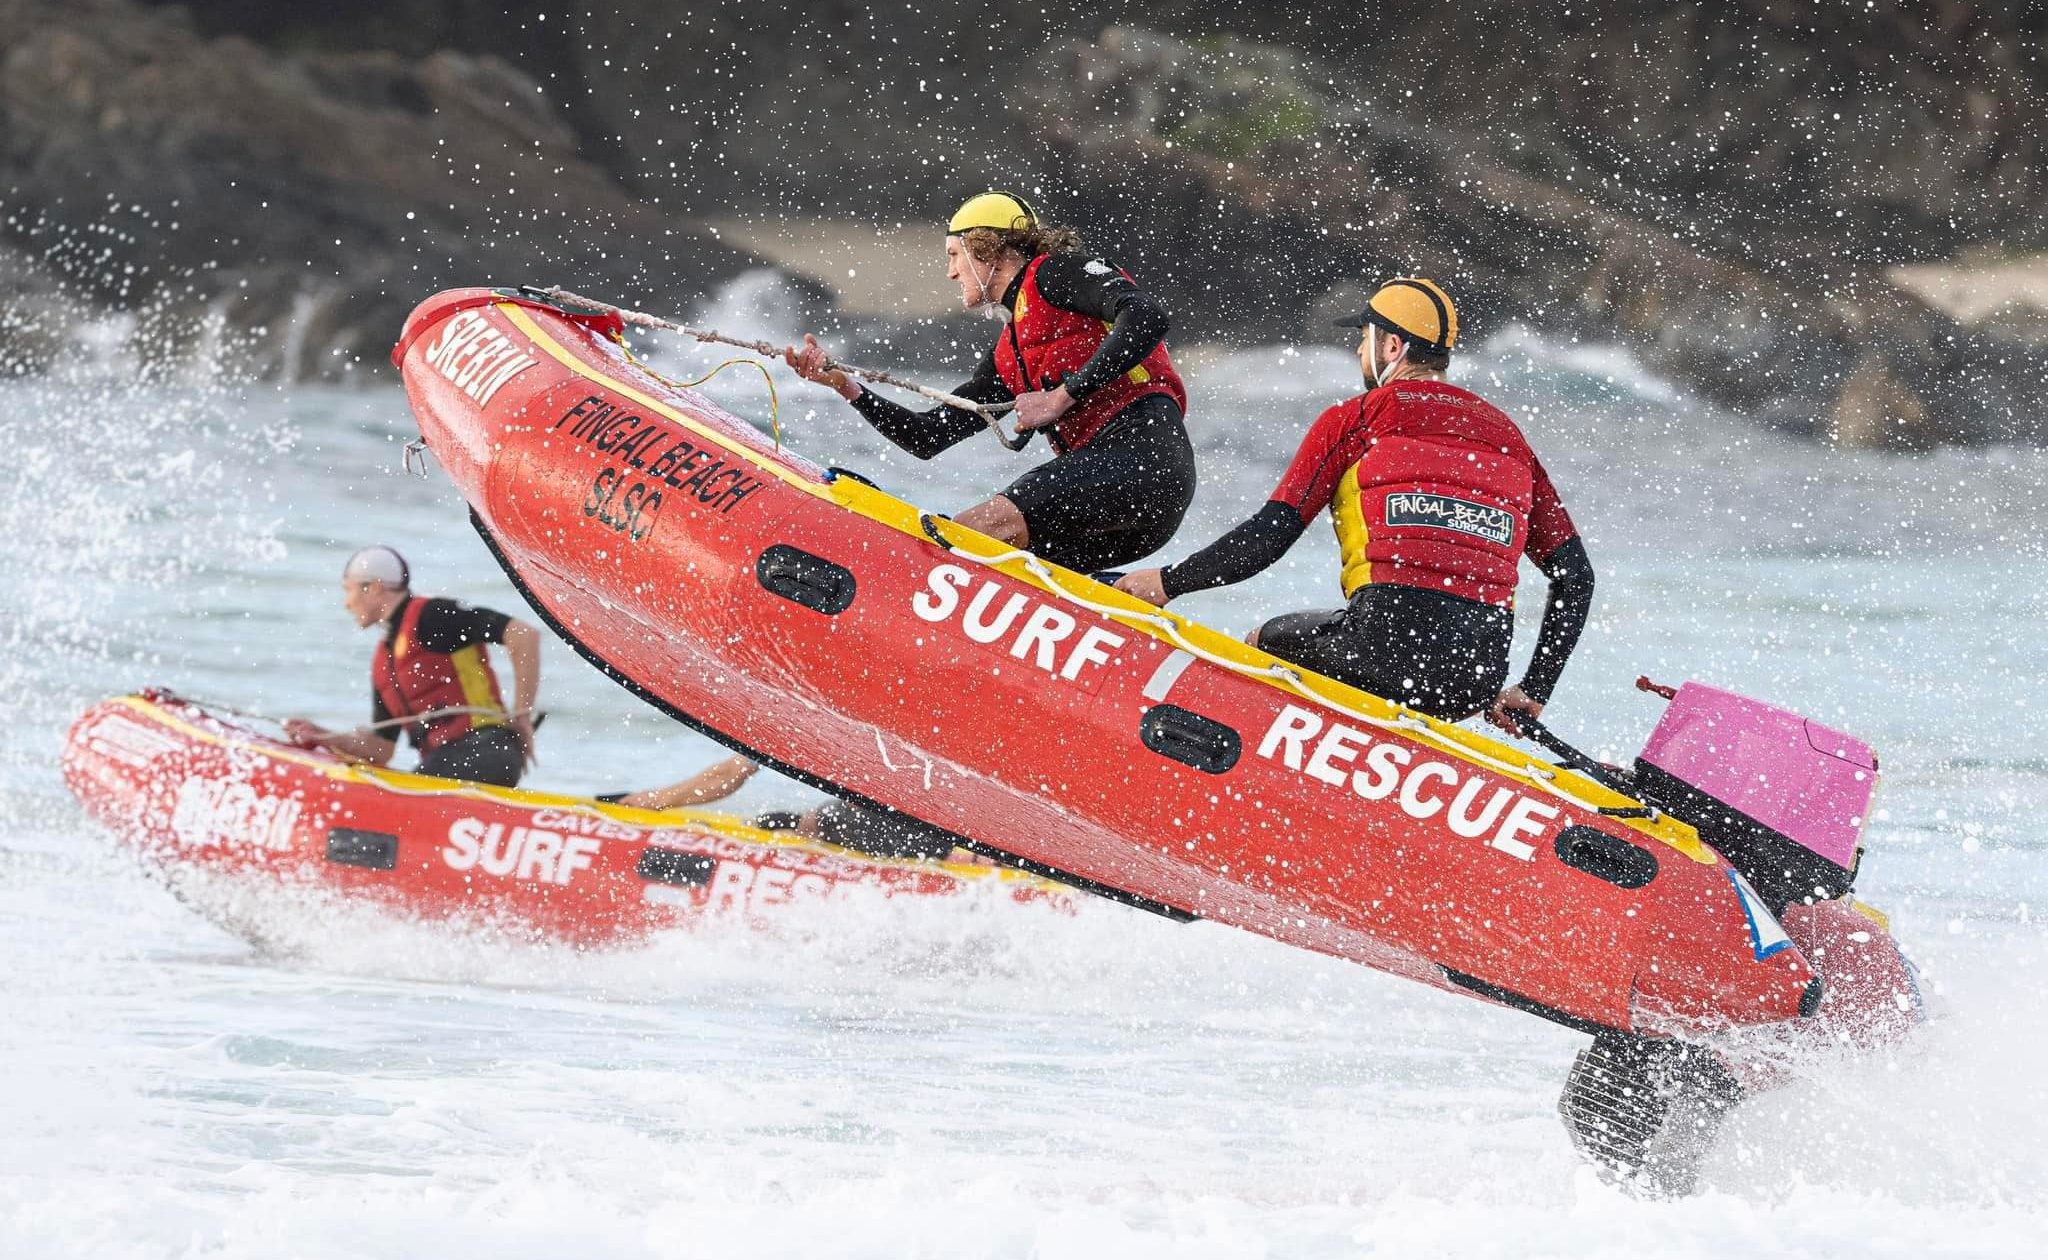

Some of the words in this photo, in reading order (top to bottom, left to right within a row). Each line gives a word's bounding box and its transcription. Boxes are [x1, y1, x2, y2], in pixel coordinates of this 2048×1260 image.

[556, 396, 669, 469] FINGAL
[648, 441, 762, 514] BEACH
[584, 467, 662, 541] SLSC
[1390, 495, 1454, 518] FINGAL
[1452, 503, 1510, 536] BEACH
[912, 564, 1126, 681] SURF
[1256, 704, 1559, 861] RESCUE
[443, 818, 602, 885] SURF
[531, 811, 642, 842] CAVES
